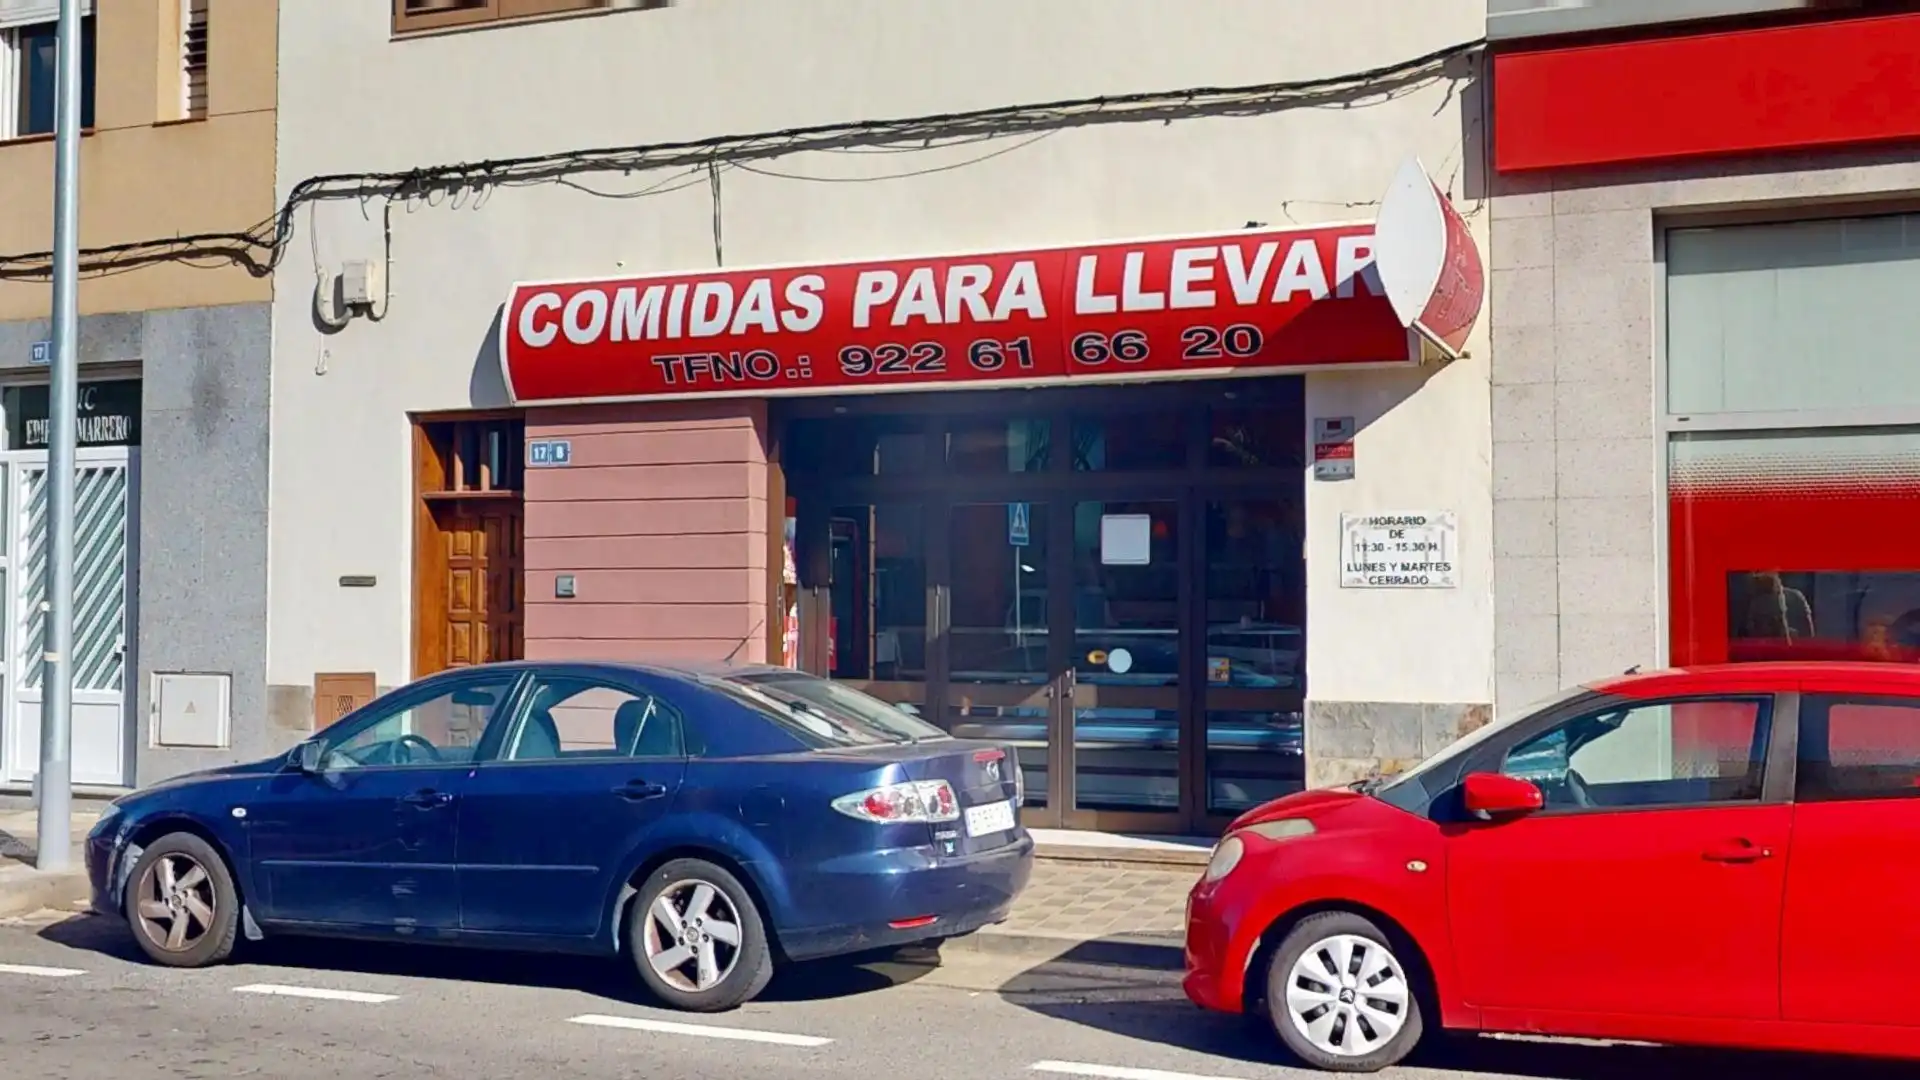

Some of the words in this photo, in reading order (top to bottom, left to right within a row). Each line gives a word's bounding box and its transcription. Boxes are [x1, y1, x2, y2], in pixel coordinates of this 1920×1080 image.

[518, 275, 825, 348] COMIDAS
[853, 260, 1048, 328] PARA
[1075, 234, 1384, 315] LLEVAR
[838, 342, 946, 376] 922
[968, 336, 1034, 371] 61
[1071, 329, 1150, 365] 66
[1181, 324, 1264, 360] 20
[534, 446, 547, 460] 17
[1368, 516, 1427, 526] HORARIO
[1388, 529, 1405, 539] DE
[1346, 562, 1387, 573] LUNES
[1389, 562, 1398, 572] Y
[1400, 562, 1452, 572] MARTES
[1368, 575, 1429, 585] CERRADO
